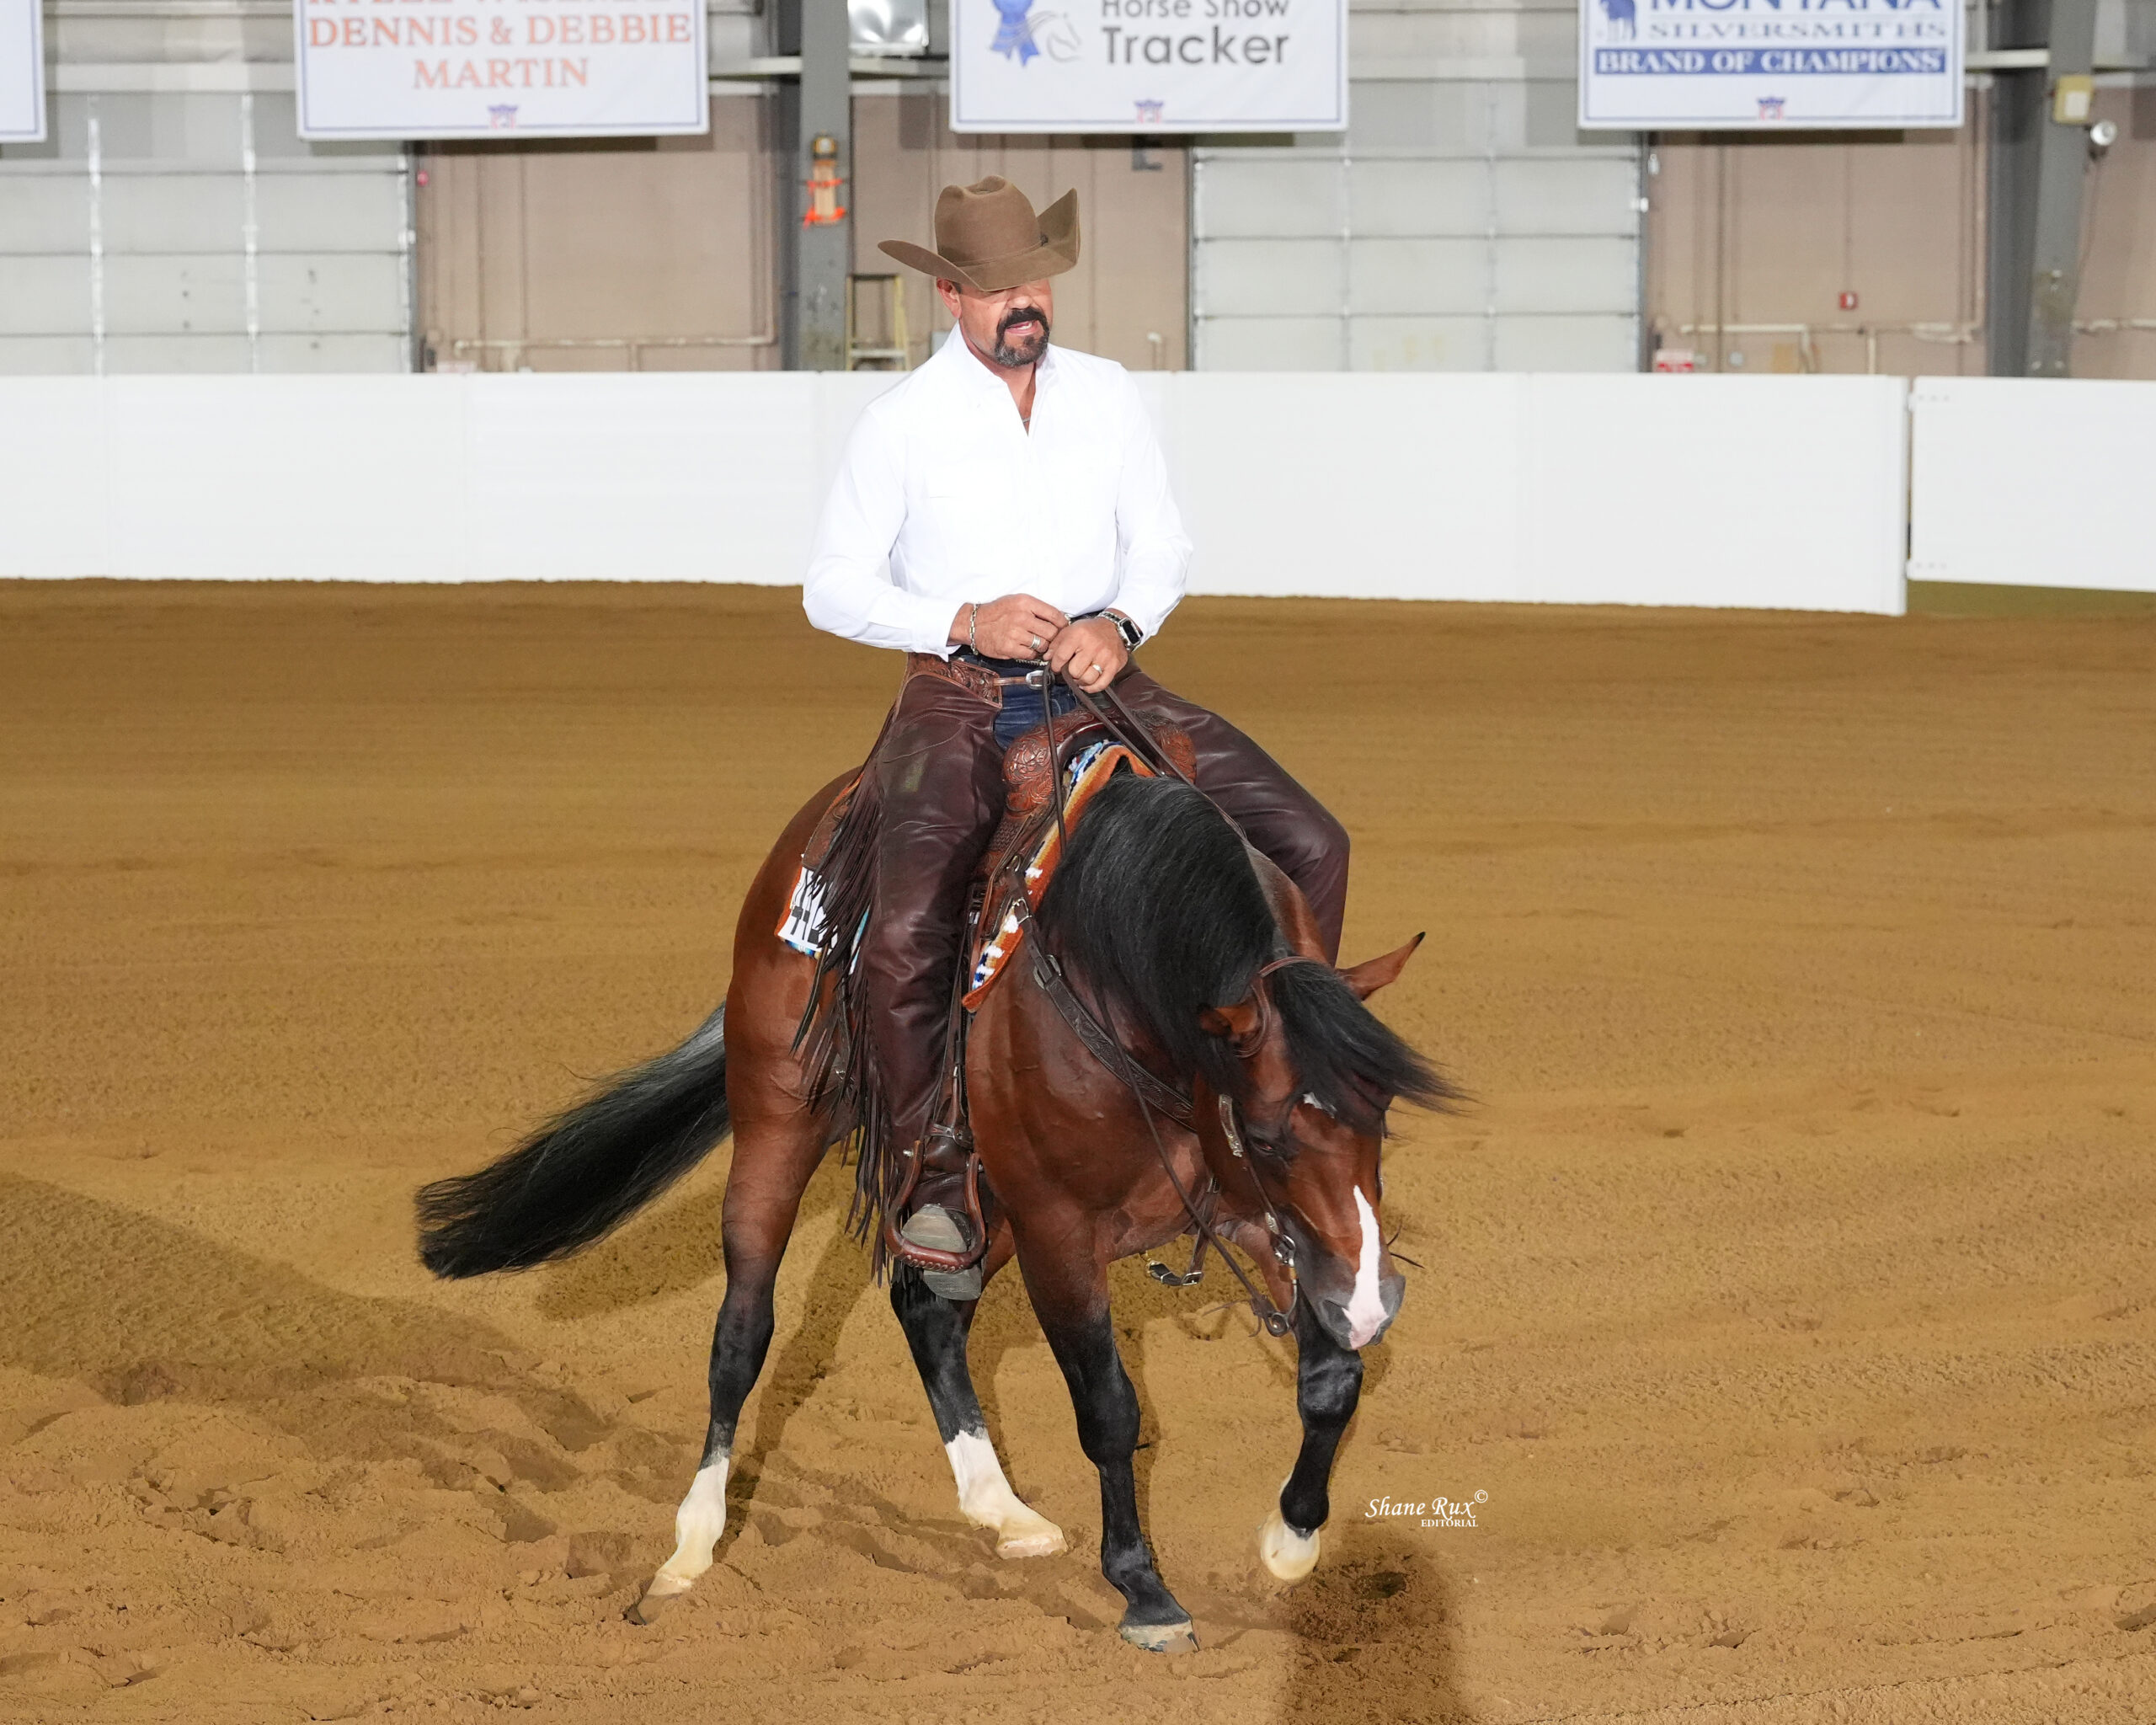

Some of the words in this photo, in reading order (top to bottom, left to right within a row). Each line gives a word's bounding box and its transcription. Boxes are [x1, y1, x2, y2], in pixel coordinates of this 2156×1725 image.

[1102, 0, 1192, 18] Horse
[1204, 0, 1289, 18] Show
[309, 16, 478, 47] DENNIS
[491, 16, 512, 45] &
[528, 13, 691, 45] DEBBIE
[1649, 23, 1945, 39] SILVERSMITHS
[1102, 25, 1289, 65] Tracker
[414, 57, 588, 88] MARTIN
[1598, 50, 1706, 73] BRAND
[1710, 51, 1755, 73] OF
[1760, 50, 1941, 73] CHAMPIONS
